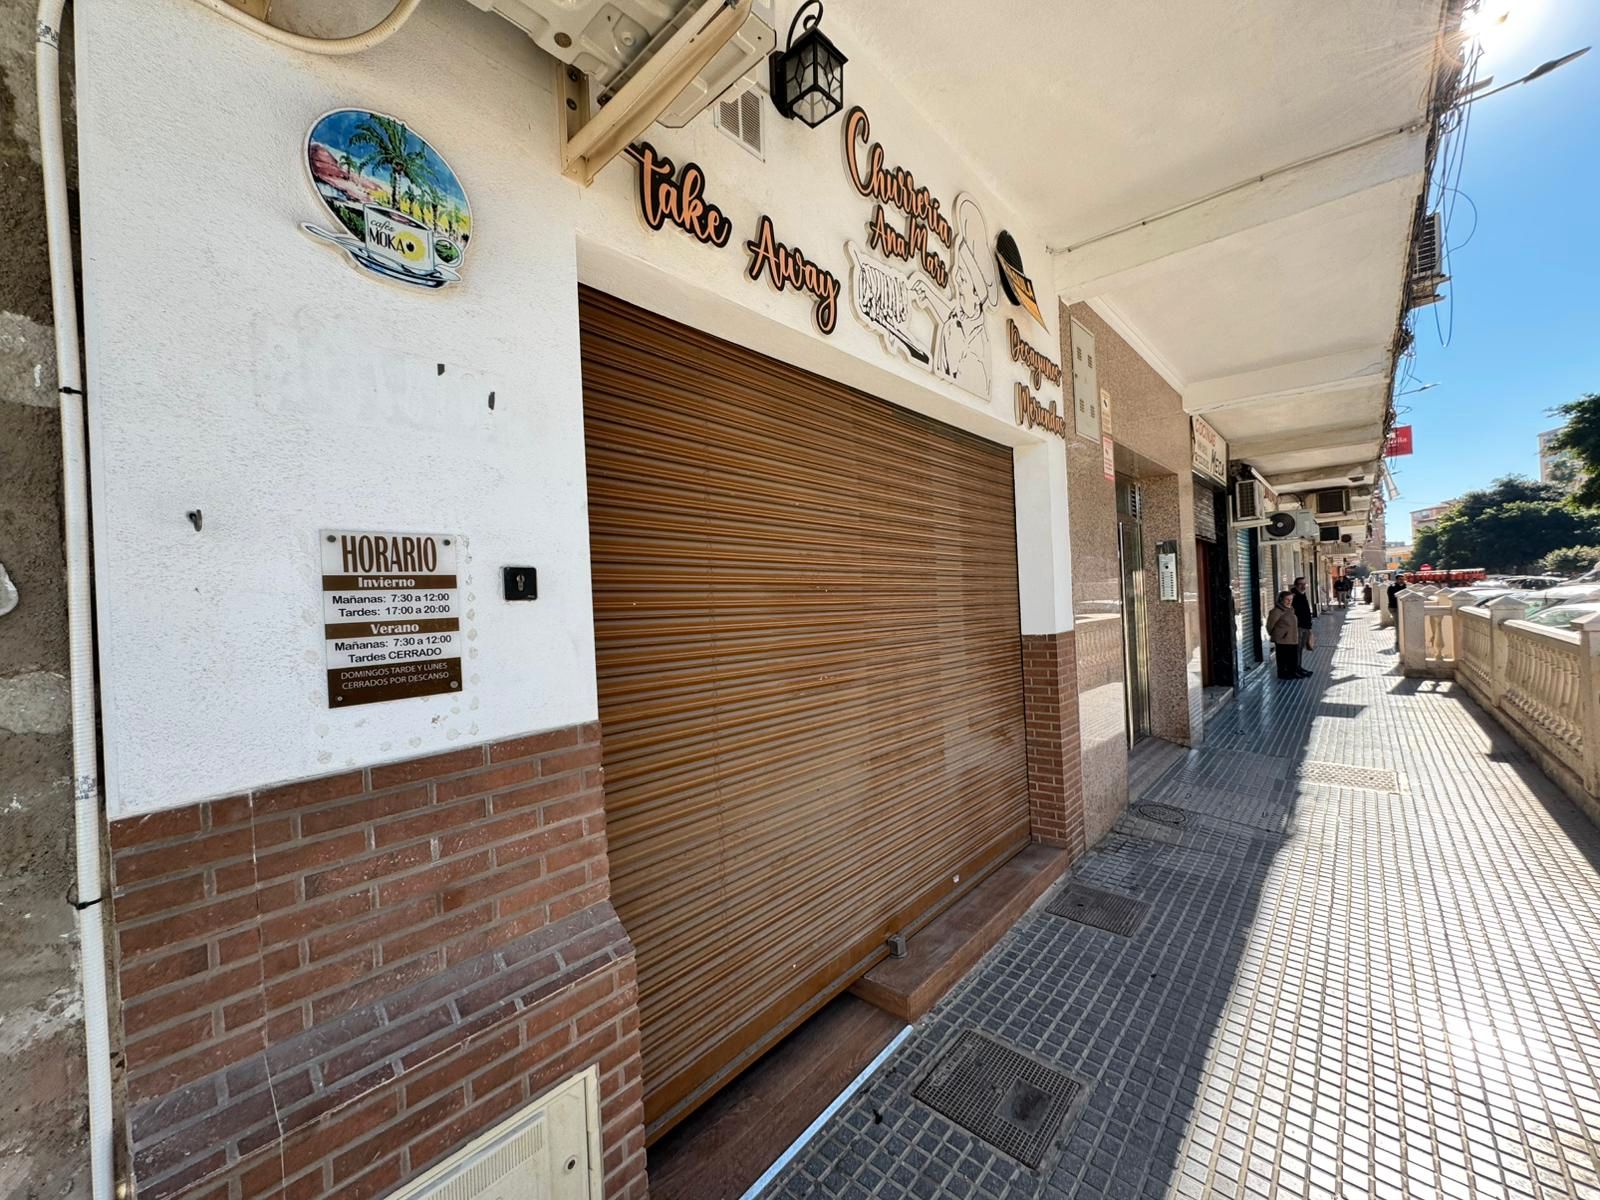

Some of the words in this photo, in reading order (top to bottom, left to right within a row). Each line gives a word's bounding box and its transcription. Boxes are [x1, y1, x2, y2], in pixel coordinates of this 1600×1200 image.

[370, 227, 406, 254] MOKA
[625, 141, 733, 248] take
[747, 215, 841, 335] Away
[869, 204, 909, 262] Ana
[909, 215, 949, 288] Mari
[1007, 318, 1062, 390] Desayunos
[1015, 382, 1066, 439] Meriendas
[341, 535, 437, 573] HORARIO
[358, 577, 416, 588] Invierno
[332, 595, 387, 605] Mañanas:
[391, 594, 413, 602] 7:30
[423, 593, 450, 602] 12:00
[338, 608, 381, 617] Tardes:
[385, 606, 414, 615] 17:00
[423, 605, 450, 614] 20:00
[370, 623, 420, 635] Verano
[334, 641, 389, 651] Mañanas:
[393, 638, 416, 647] 7:30
[425, 635, 452, 644] 12:00
[348, 653, 387, 663] Tardes
[388, 647, 442, 660] CERRADO
[340, 667, 390, 680] DOMINGOS
[391, 664, 416, 674] TARDE
[416, 664, 423, 672] Y
[423, 661, 448, 671] LUNES
[342, 677, 389, 690] CERRADOS
[390, 676, 407, 685] POR
[407, 671, 450, 682] DESCANSO
